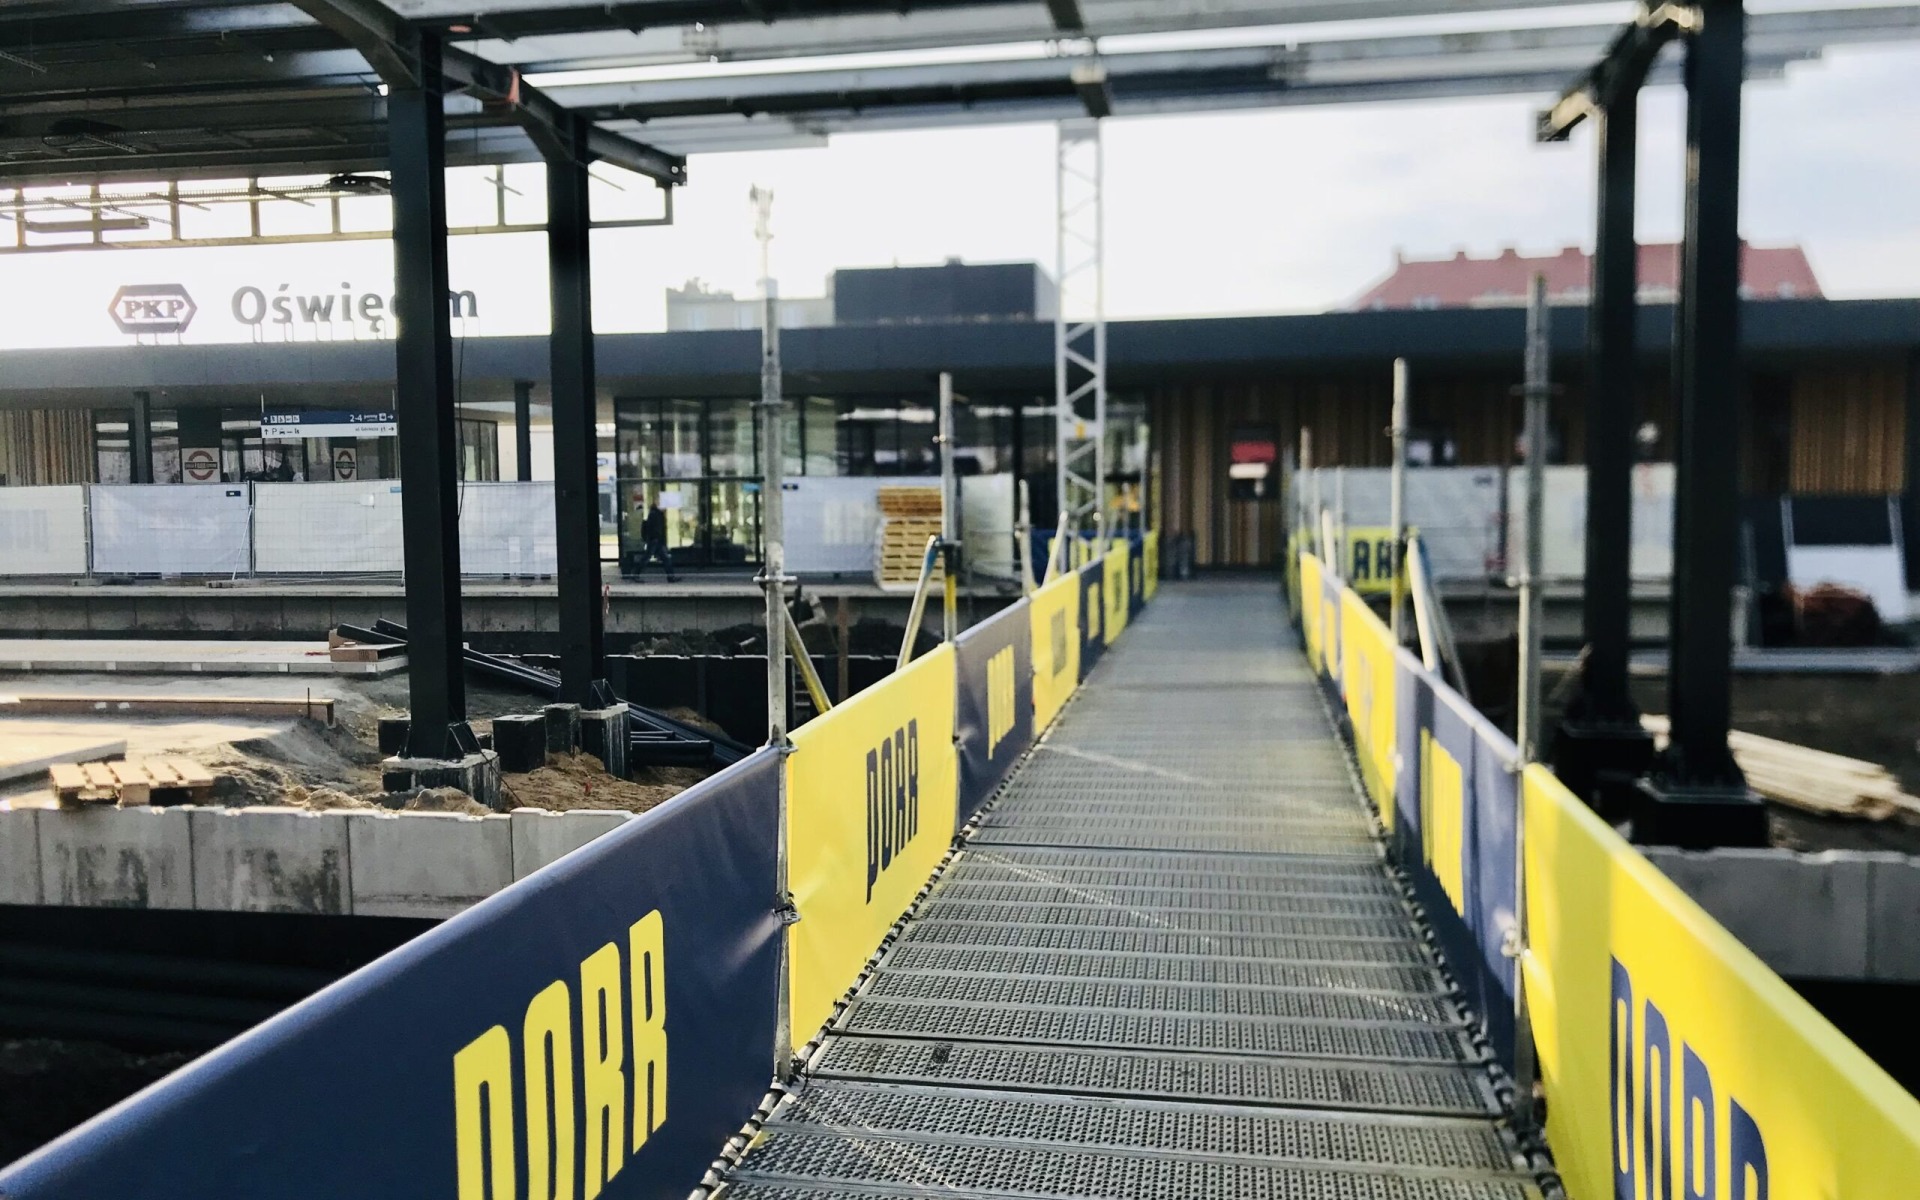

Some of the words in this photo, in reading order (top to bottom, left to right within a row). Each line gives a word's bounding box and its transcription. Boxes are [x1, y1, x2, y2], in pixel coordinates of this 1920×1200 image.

[122, 299, 185, 319] PKP
[231, 282, 478, 332] Oświęm
[866, 718, 918, 906] PORR
